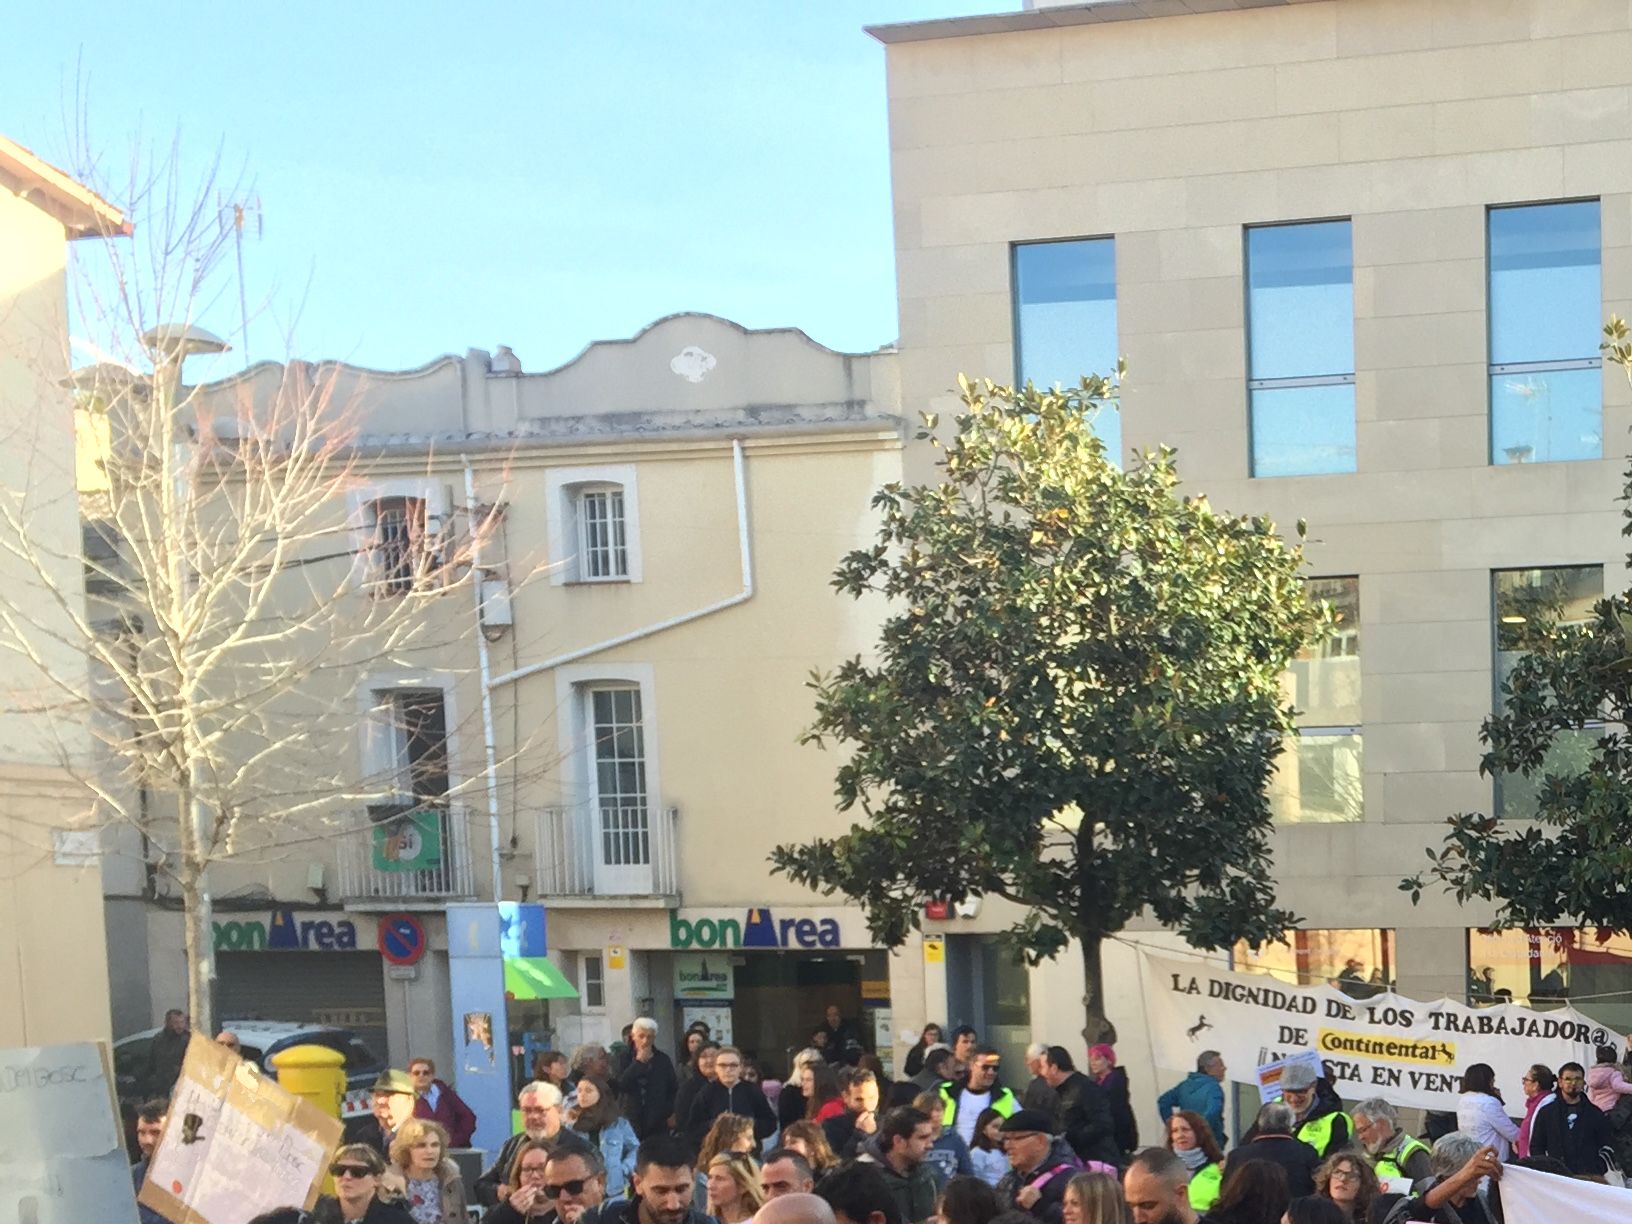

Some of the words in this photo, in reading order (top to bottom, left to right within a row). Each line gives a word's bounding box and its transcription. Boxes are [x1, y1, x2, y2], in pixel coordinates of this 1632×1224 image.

[1171, 973, 1201, 996] LA
[1208, 979, 1317, 1015] DIGNIDAD
[1325, 998, 1356, 1021] DE
[1367, 1006, 1415, 1029] LOS
[1278, 1025, 1308, 1046] DE
[1321, 1032, 1438, 1061] Continental
[1322, 1058, 1362, 1083] STA
[1371, 1066, 1403, 1088] EN
[1408, 1072, 1465, 1095] VENT
